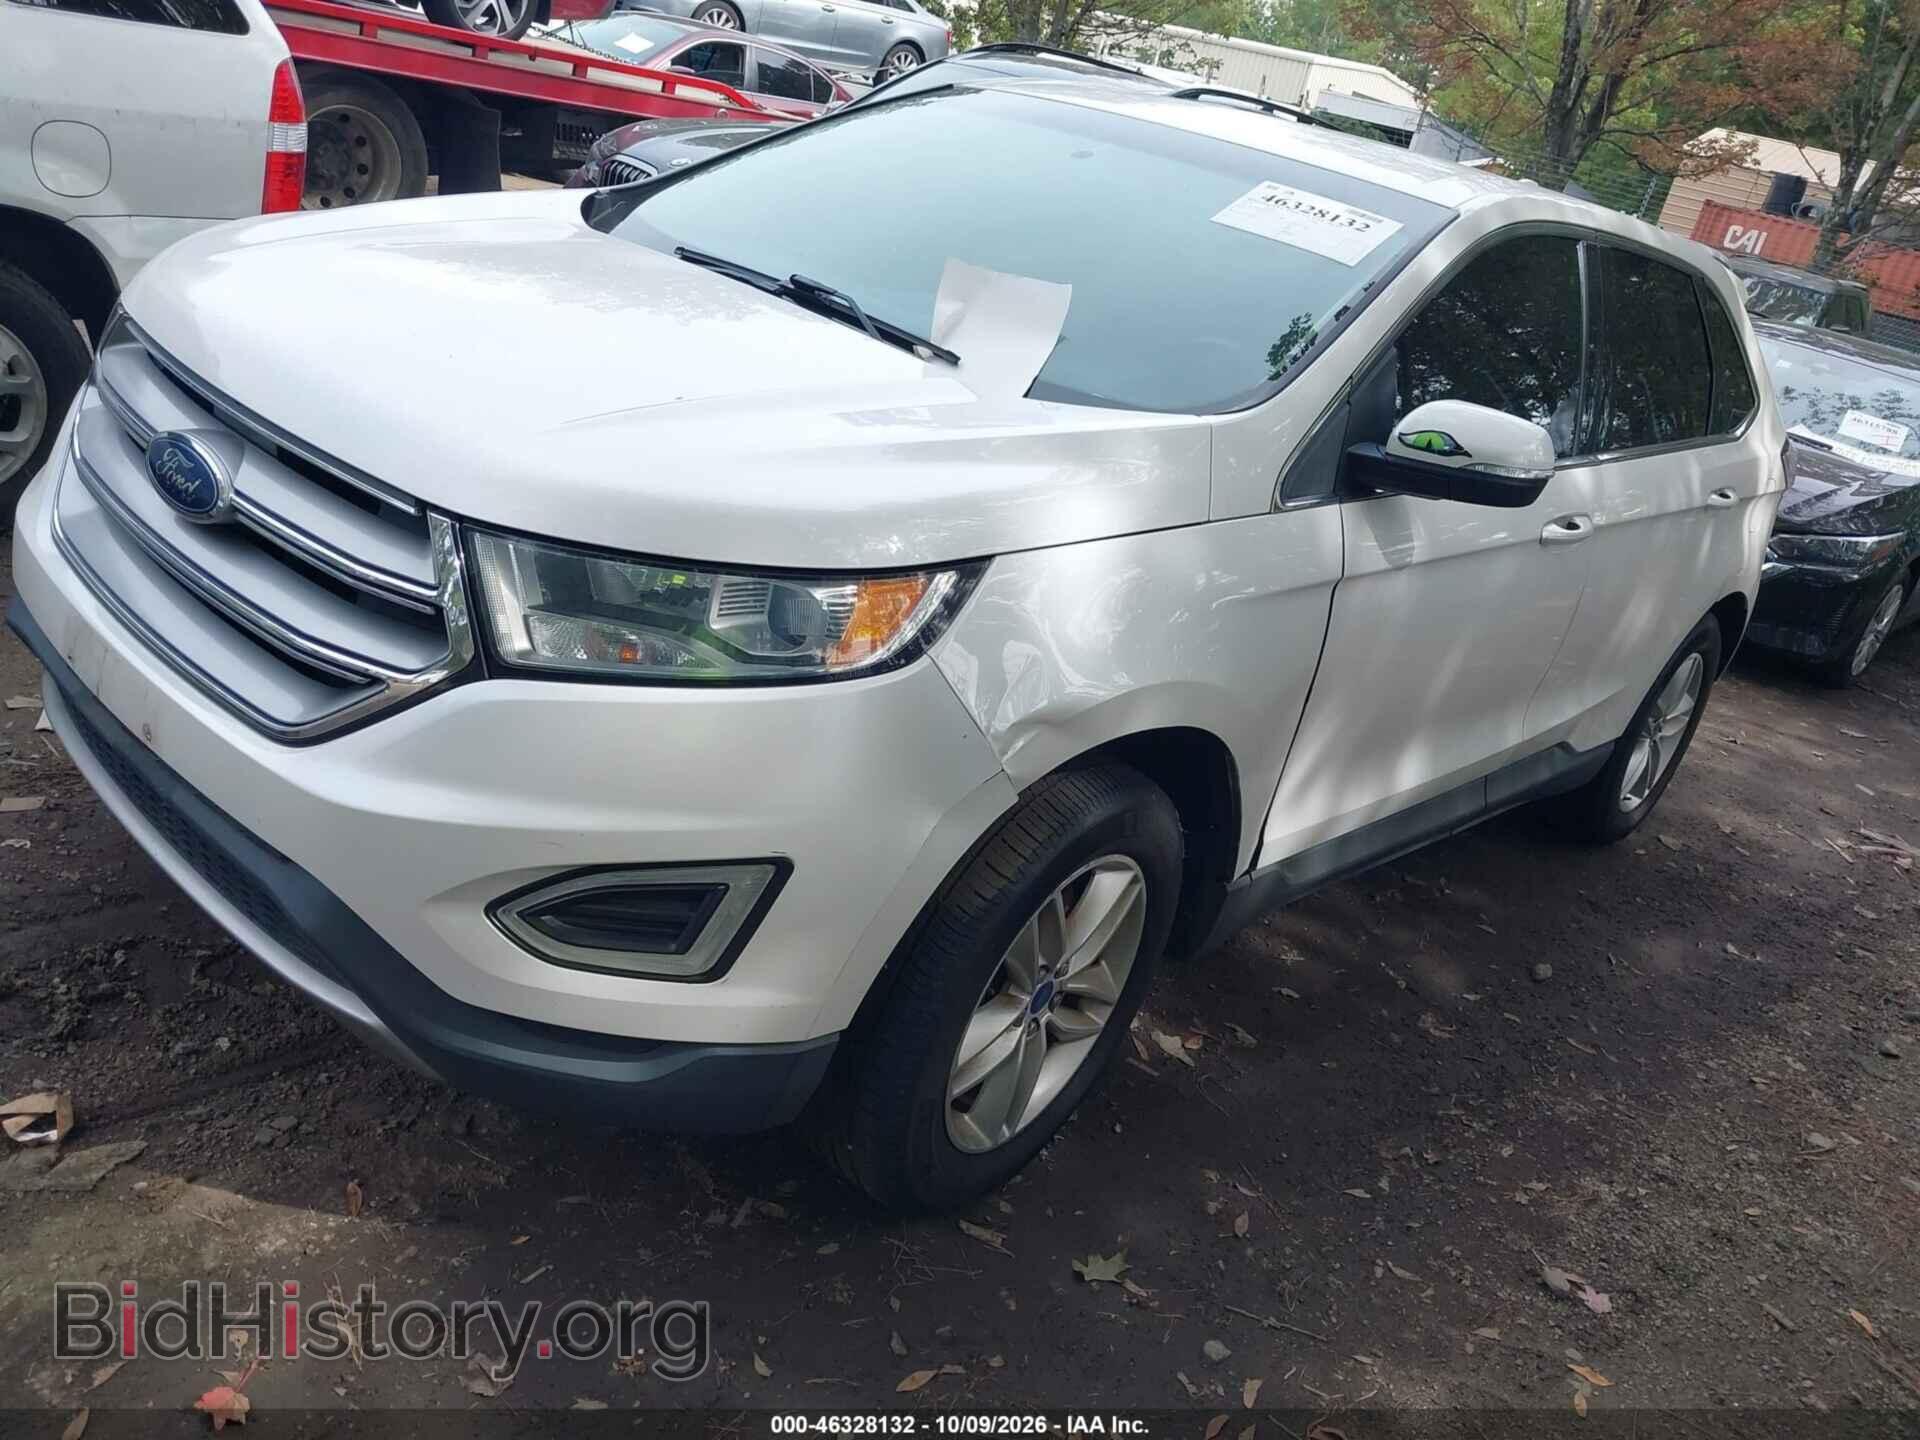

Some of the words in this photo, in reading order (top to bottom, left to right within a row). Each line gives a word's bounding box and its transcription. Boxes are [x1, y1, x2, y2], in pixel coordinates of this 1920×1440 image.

[1261, 193, 1372, 233] 46328132
[1723, 224, 1768, 255] CAI
[155, 447, 202, 498] Ford
